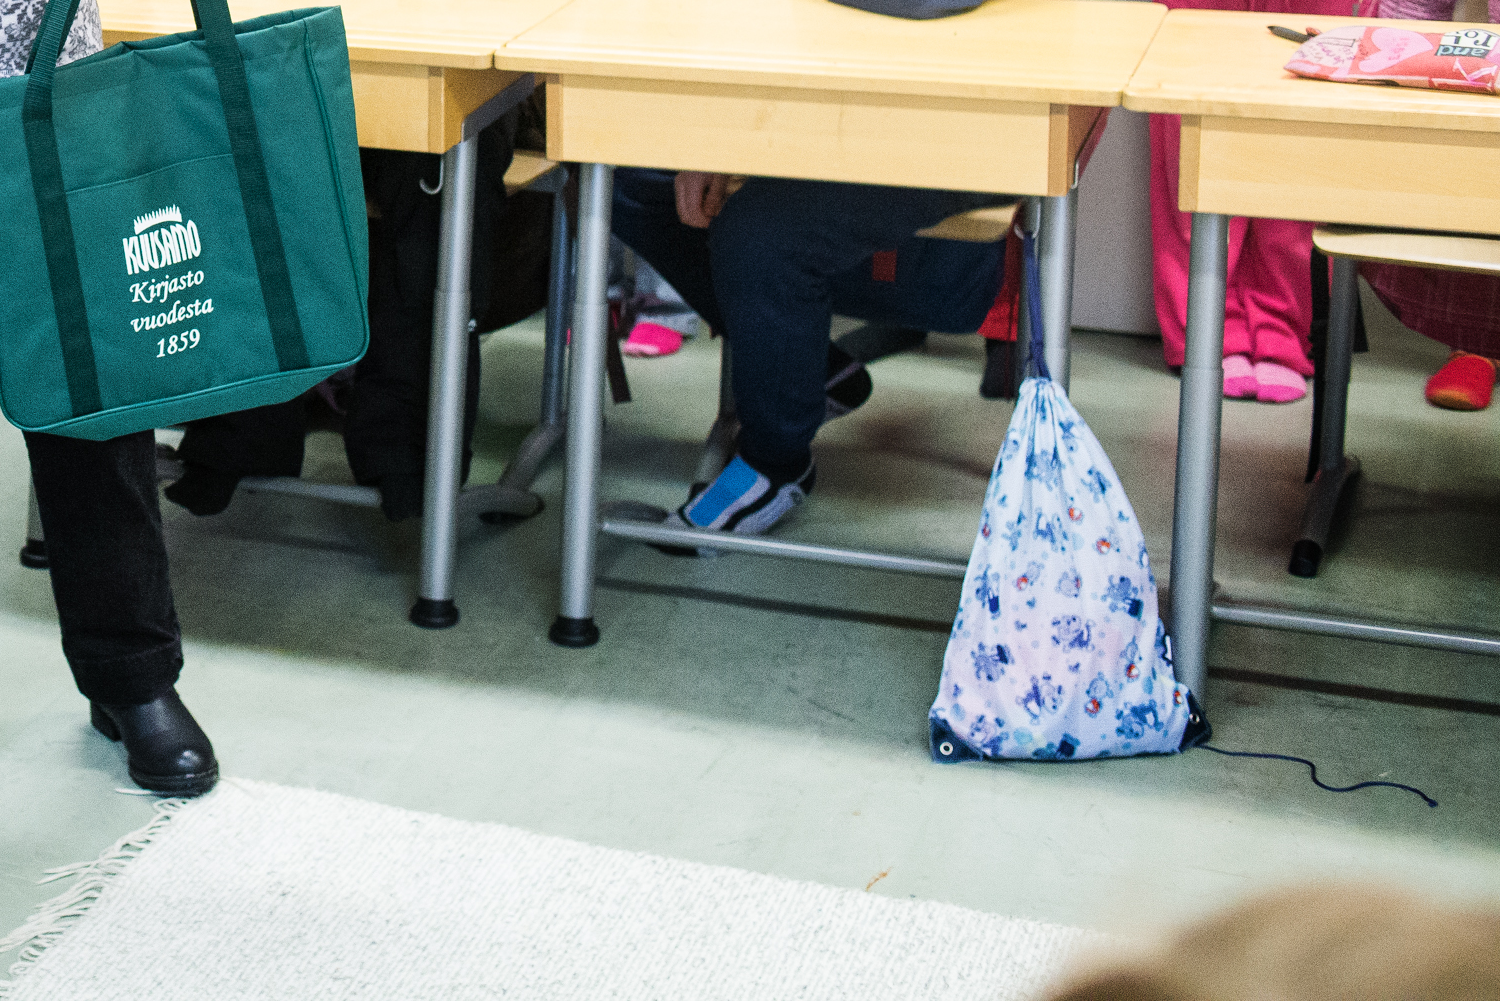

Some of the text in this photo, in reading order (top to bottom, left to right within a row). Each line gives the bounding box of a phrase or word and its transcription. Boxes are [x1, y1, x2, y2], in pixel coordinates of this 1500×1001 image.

[122, 219, 202, 276] KUUSAMO
[129, 270, 205, 304] Kirjasto
[130, 298, 215, 333] vuodesta
[156, 328, 201, 358] 1859
